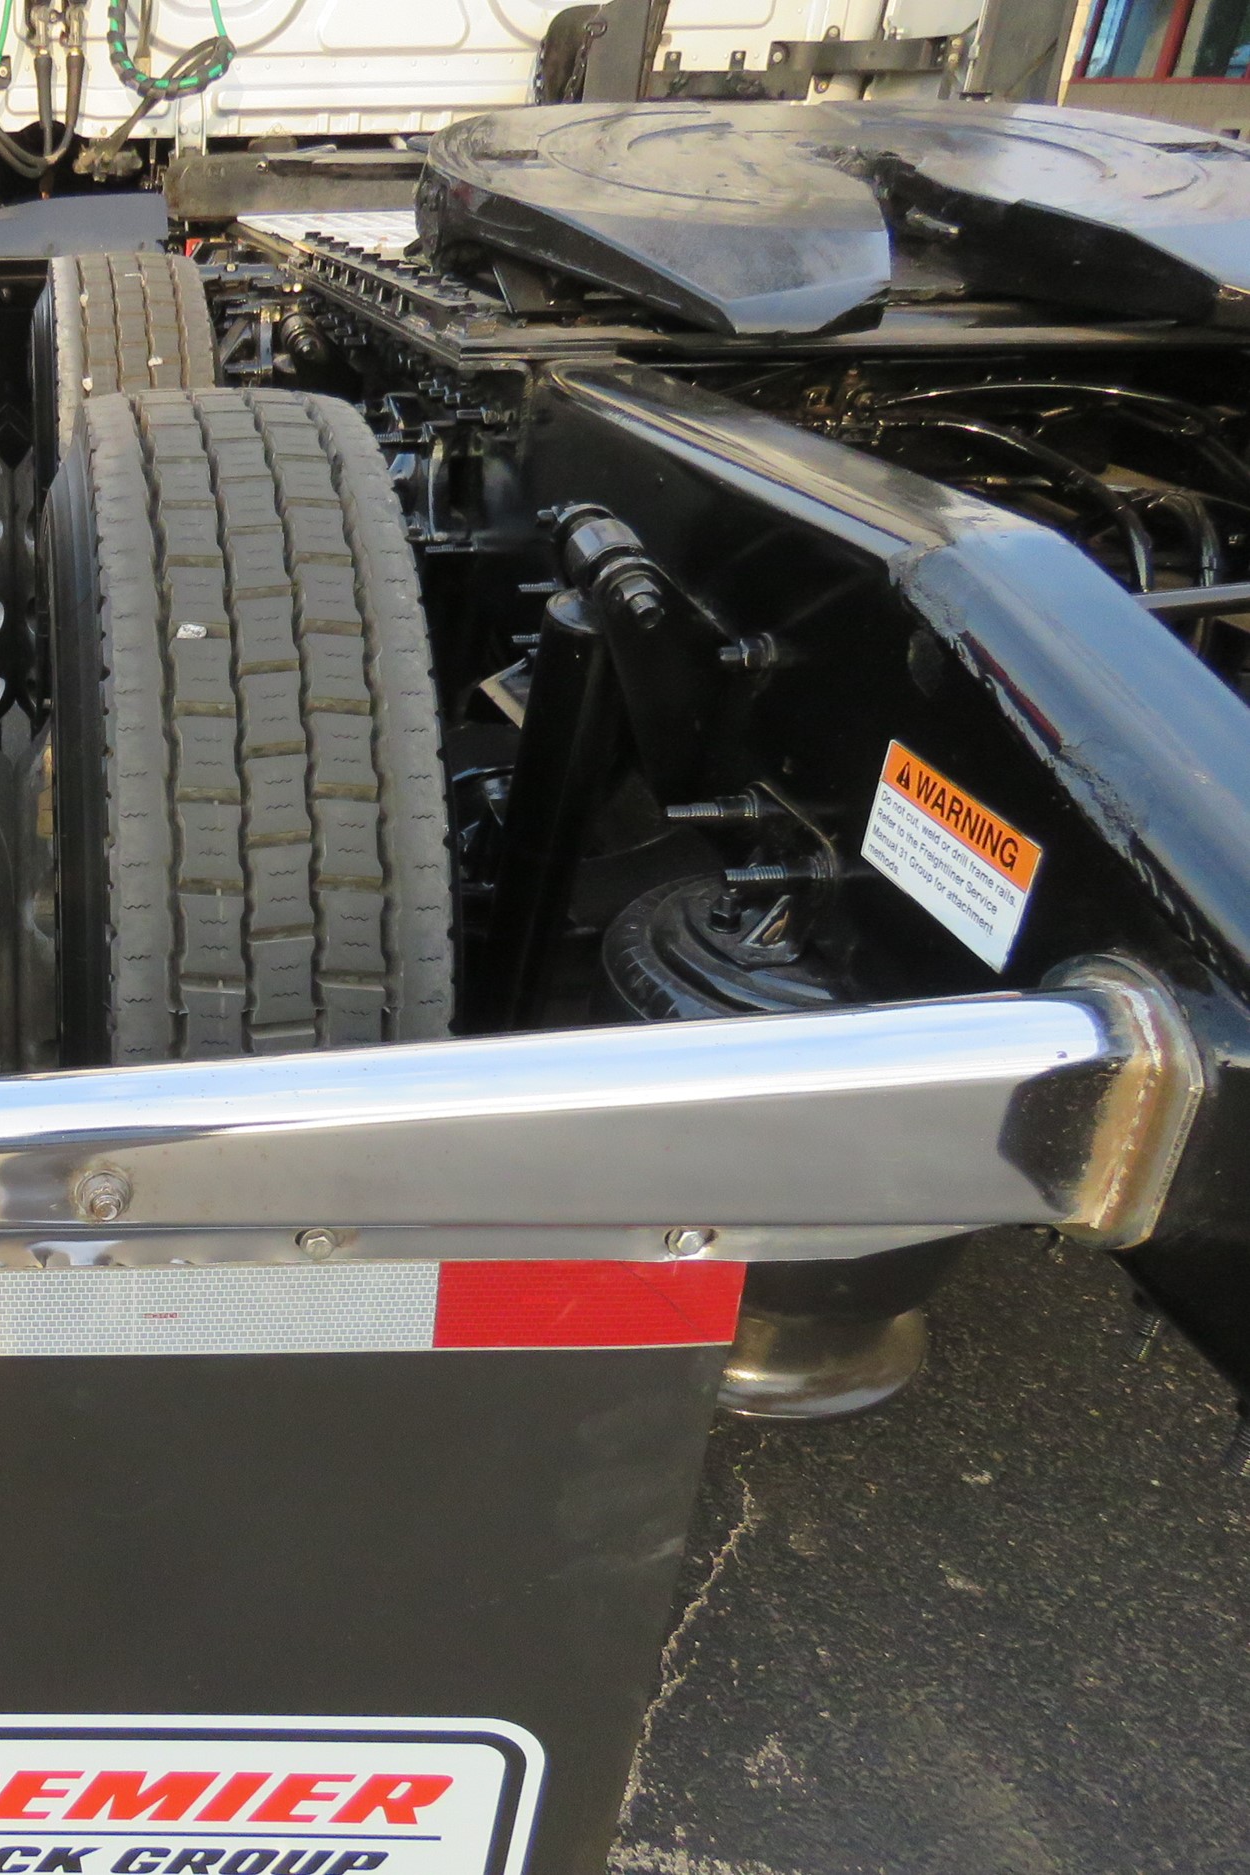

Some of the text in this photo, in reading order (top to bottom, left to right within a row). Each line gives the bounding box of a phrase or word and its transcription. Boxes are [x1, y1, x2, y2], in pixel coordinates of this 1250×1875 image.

[868, 843, 900, 876] methods.
[877, 807, 998, 914] Refer to the Freightliner Service
[881, 790, 1016, 908] Do not cut, weld or drill frame rails.
[916, 770, 1019, 871] WARNING
[872, 824, 994, 936] Manual 31 Group for attachment
[110, 1847, 389, 1875] GROUP
